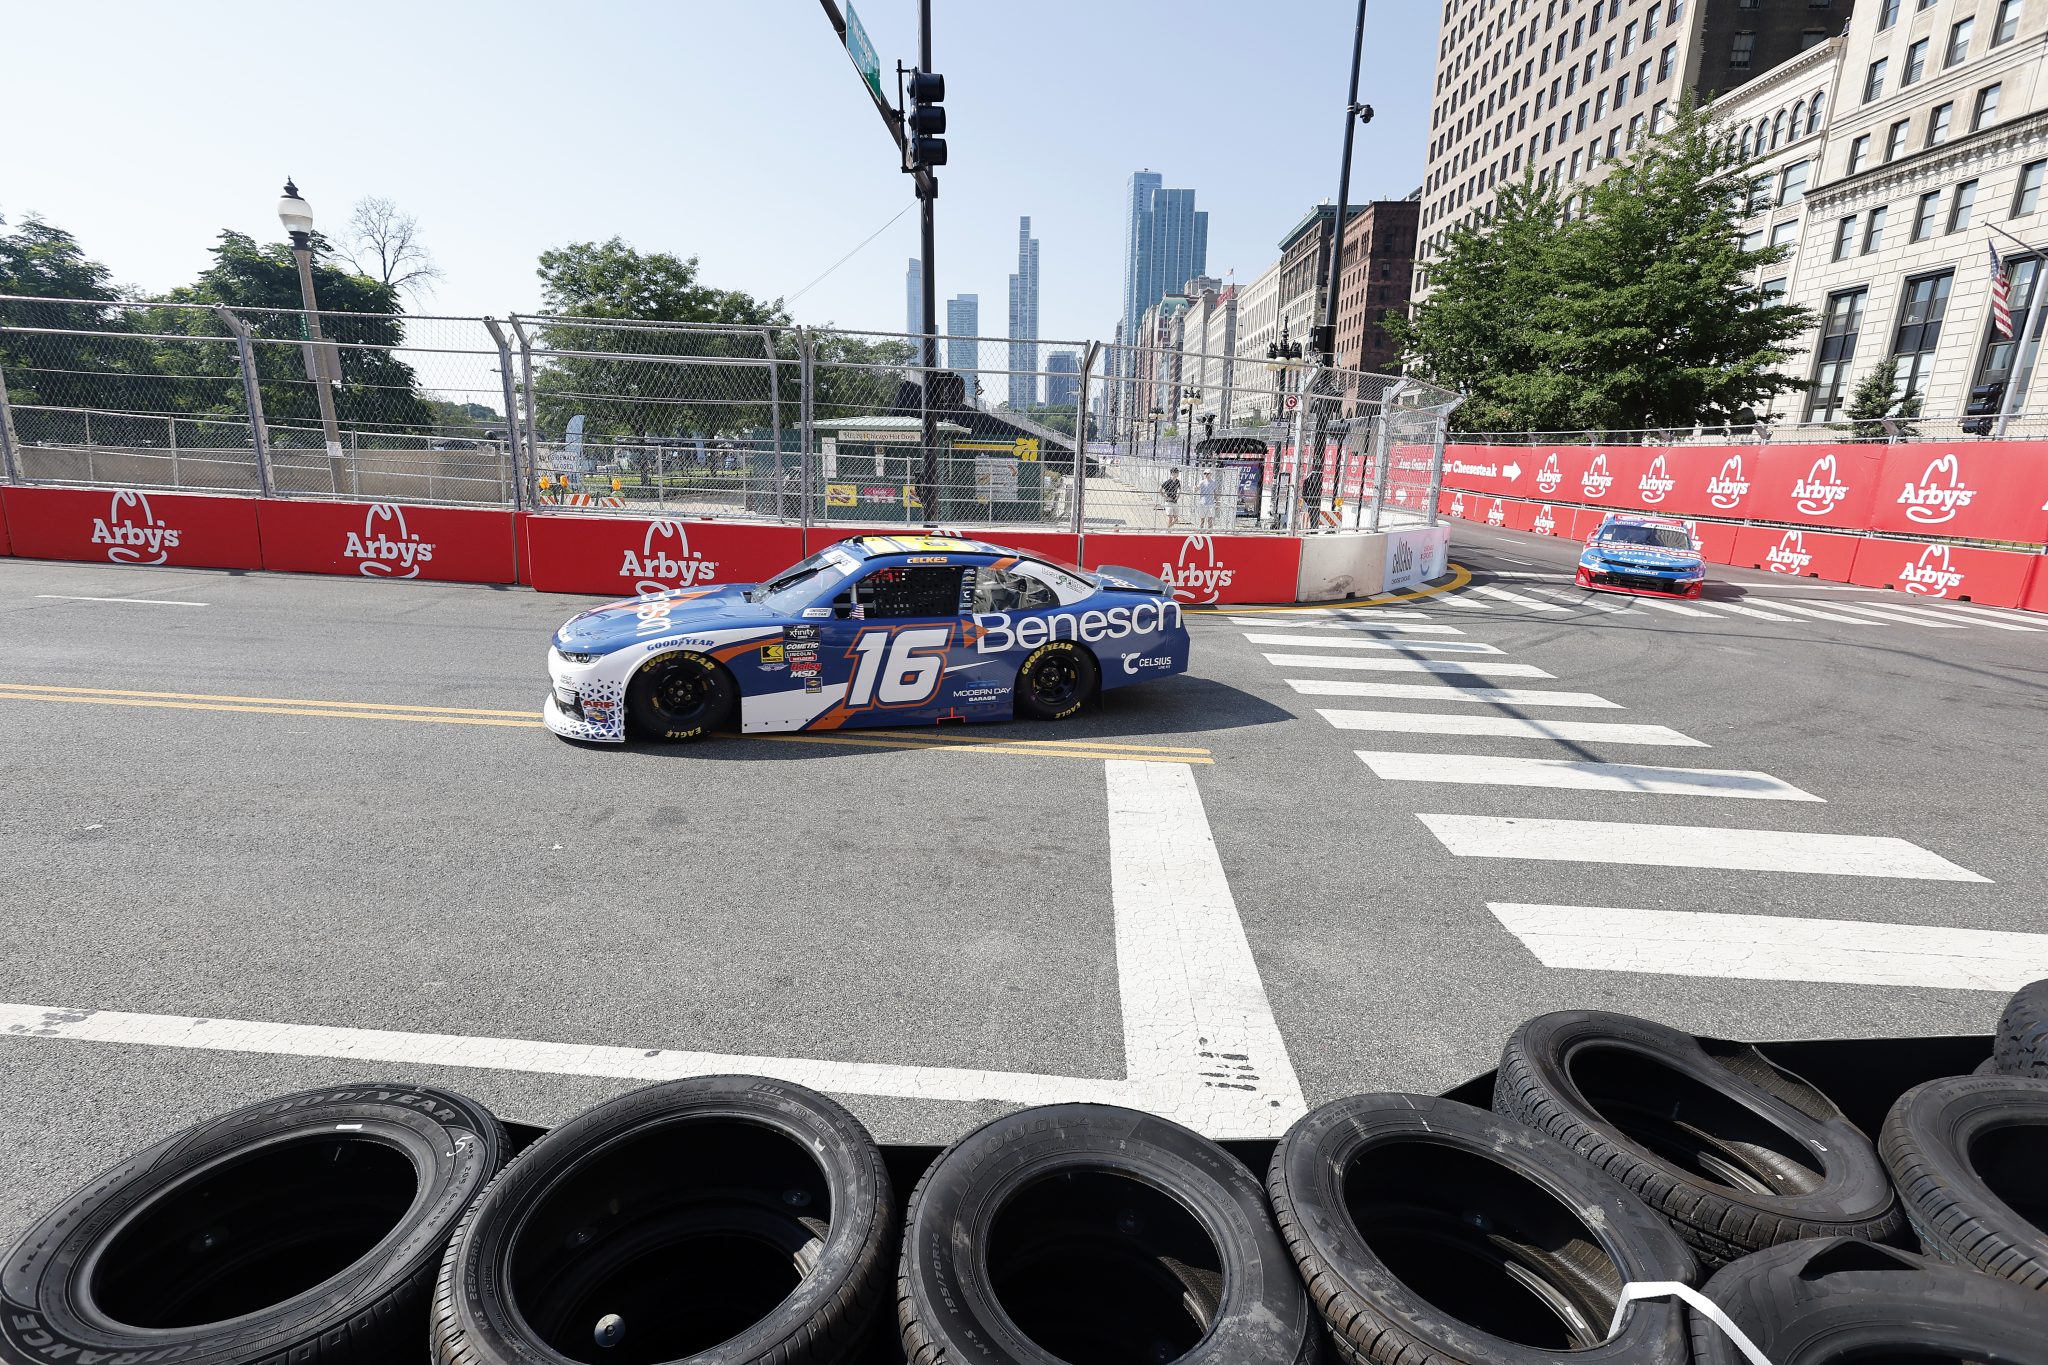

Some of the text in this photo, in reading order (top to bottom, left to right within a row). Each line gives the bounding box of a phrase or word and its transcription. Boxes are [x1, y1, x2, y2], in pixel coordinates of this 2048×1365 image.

[1453, 460, 1498, 478] Cheesesteak
[1536, 469, 1563, 486] Arby's
[1581, 470, 1614, 489] Arby's
[1638, 472, 1676, 493] Arby's
[1707, 476, 1750, 500] Arby's
[1791, 478, 1848, 503] Arby's
[1897, 482, 1974, 511] Arby's
[1487, 508, 1505, 522] Arby's
[1534, 515, 1556, 530] Arby's
[91, 518, 182, 554] Arby's
[343, 531, 435, 568] Arby's
[1766, 546, 1813, 568] Arby's
[619, 550, 716, 587] Arby's
[1159, 561, 1234, 595] Arby's
[1625, 568, 1659, 576] CHEVROLET
[1899, 562, 1964, 591] Arby's
[789, 628, 815, 637] xfinity
[973, 597, 1182, 655] Benesch
[647, 637, 715, 651] GOODYEAR
[786, 641, 819, 650] COMETIC
[847, 627, 950, 706] 16
[1138, 656, 1172, 668] CELSIUS
[953, 686, 1012, 698] MODERN DAY
[583, 700, 615, 709] ARP
[1054, 700, 1082, 719] EAGLE
[664, 726, 702, 739] EAGLE
[229, 1090, 457, 1128] GOODYEAR
[467, 1235, 482, 1300] 225/45R17
[931, 1233, 959, 1315] 195/70R14
